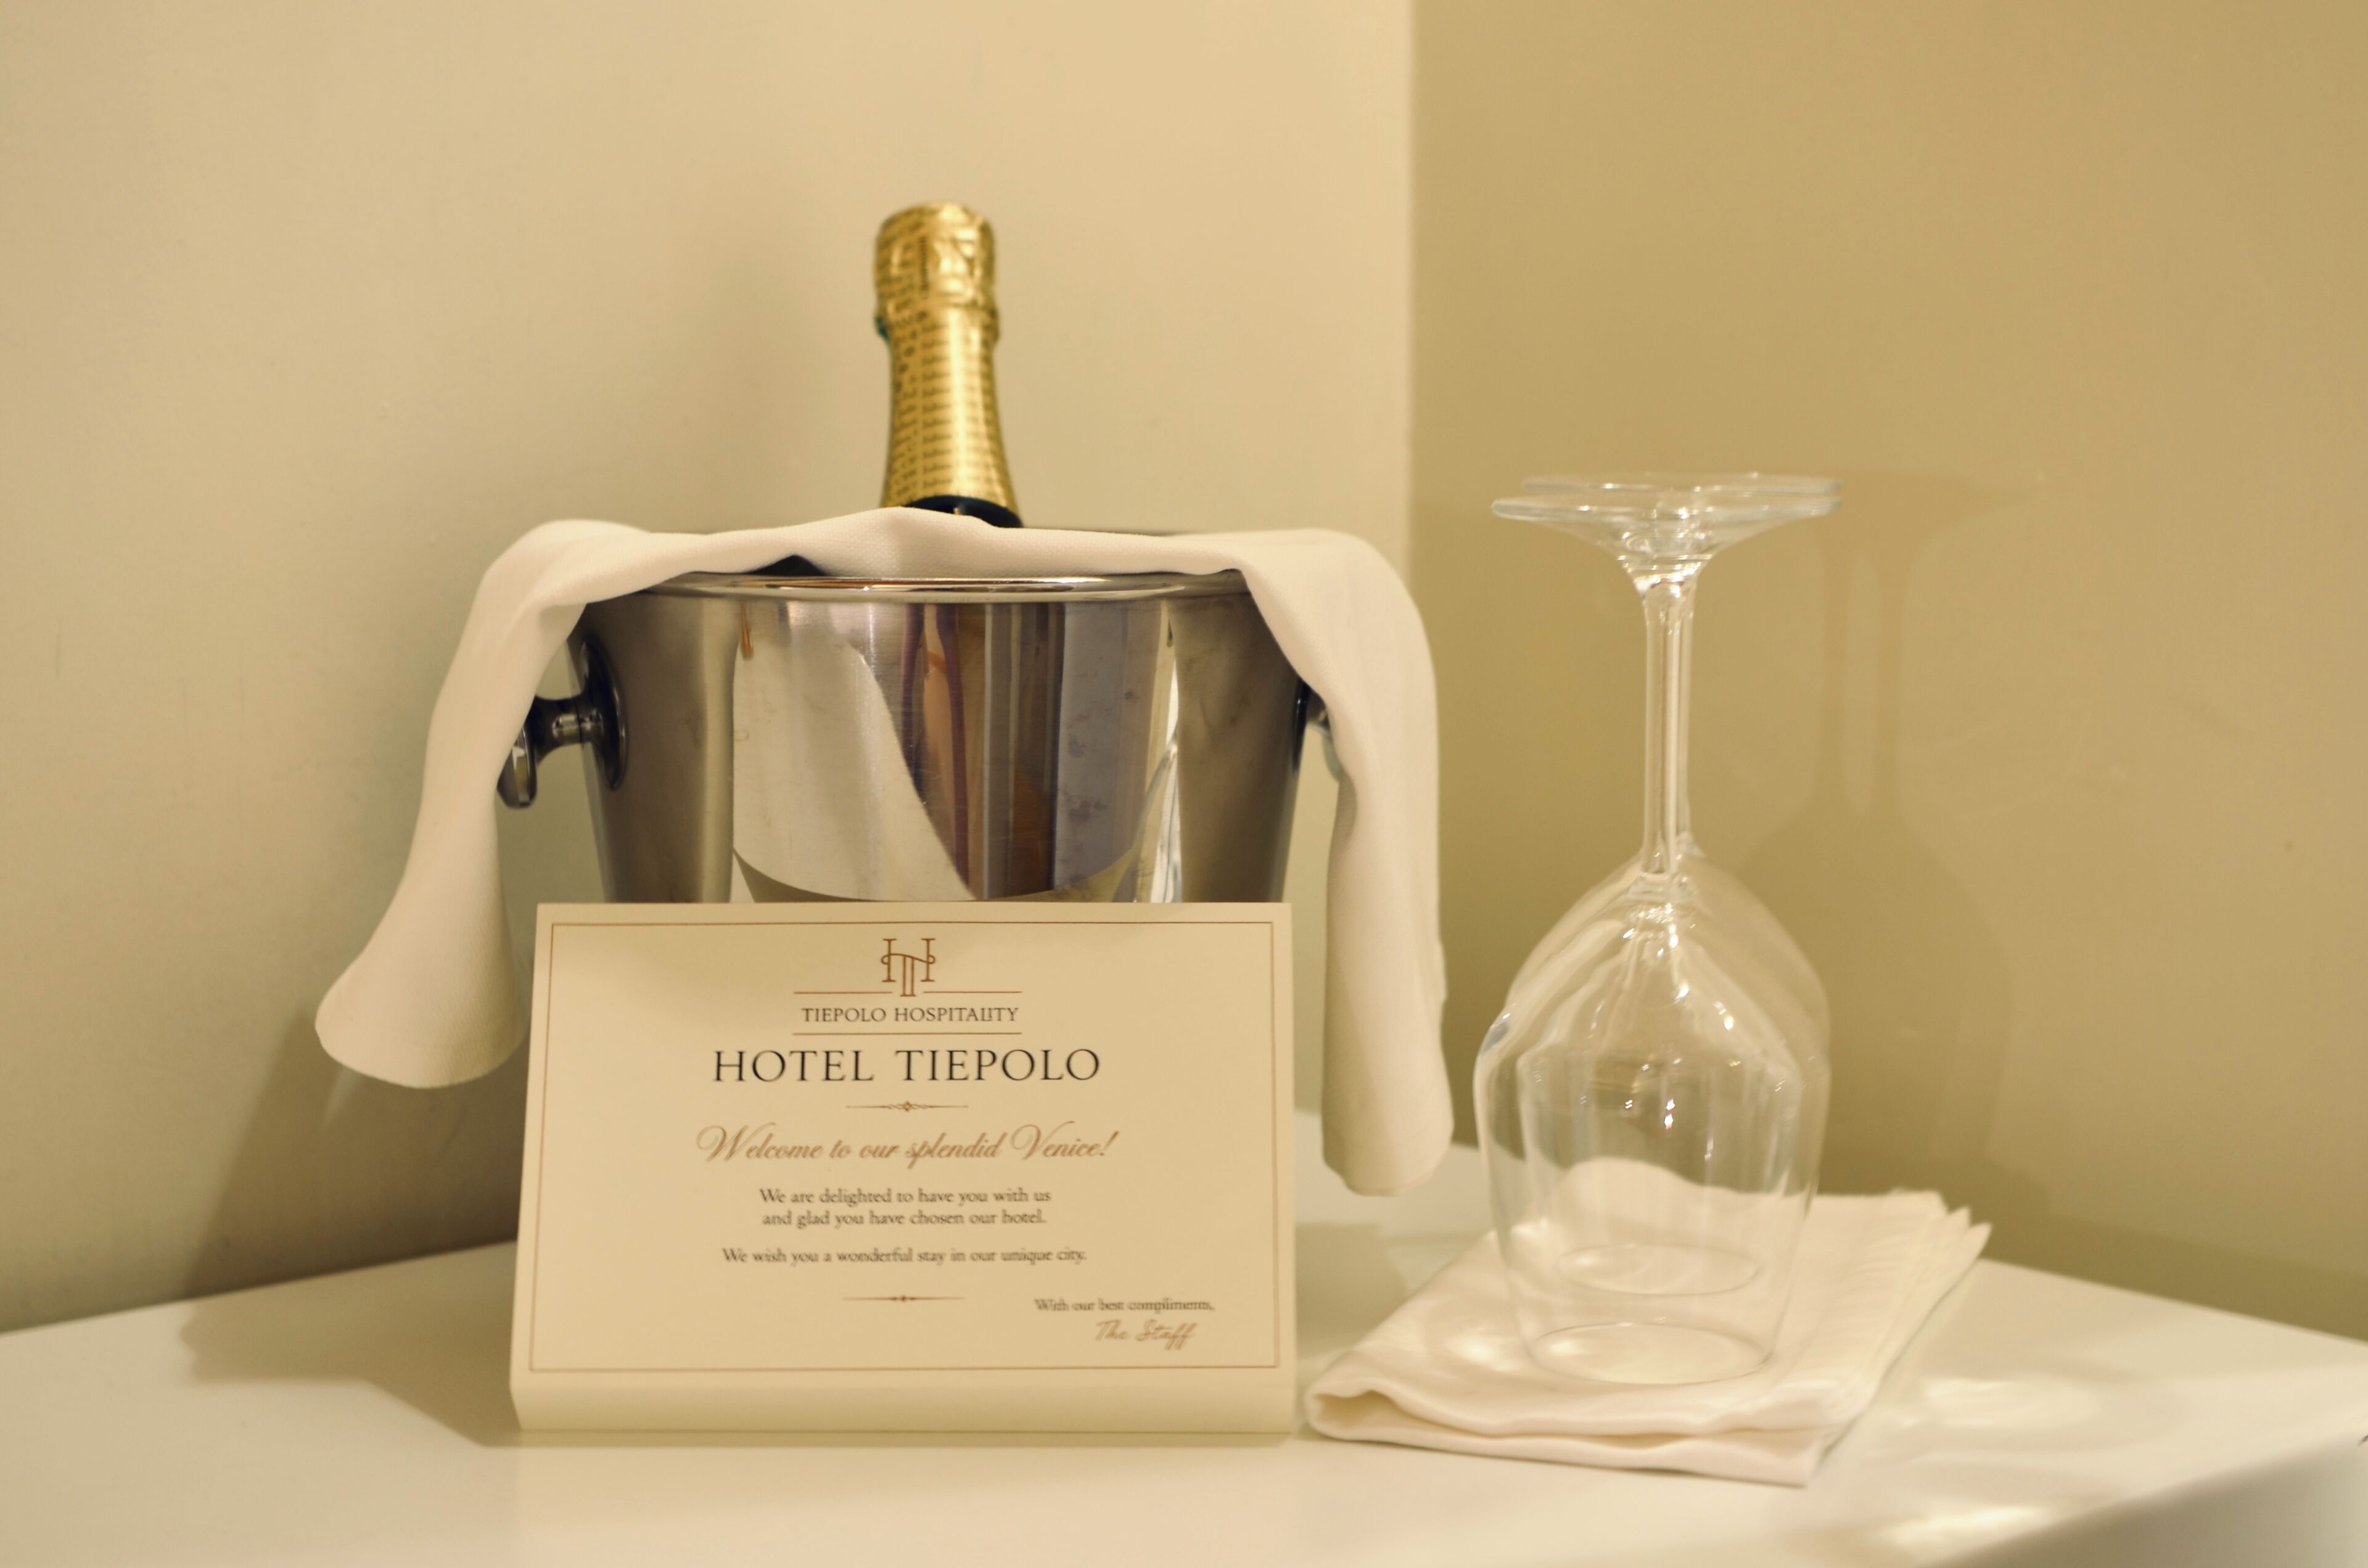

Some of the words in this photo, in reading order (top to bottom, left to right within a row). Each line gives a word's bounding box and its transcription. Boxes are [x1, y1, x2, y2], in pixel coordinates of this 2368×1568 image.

[801, 1008, 887, 1022] TIEPOLO
[894, 1007, 1019, 1022] HOSPITALITY
[713, 1049, 874, 1082] HOTEL
[895, 1048, 1100, 1081] TIEPOLO
[696, 1122, 824, 1162] Welcome
[829, 1139, 852, 1159] to
[859, 1144, 900, 1159] our
[905, 1132, 1008, 1169] splendid
[1011, 1121, 1119, 1160] Venice!
[759, 1188, 786, 1204] We
[790, 1192, 815, 1204] are
[819, 1188, 892, 1208] delighted
[897, 1192, 914, 1203] to
[918, 1188, 954, 1203] have
[958, 1192, 988, 1207] you
[992, 1187, 1029, 1202] with
[1033, 1192, 1052, 1202] us
[762, 1210, 792, 1225] and
[796, 1210, 830, 1229] glad
[834, 1214, 864, 1229] you
[869, 1210, 905, 1225] have
[909, 1209, 964, 1225] chosen
[969, 1214, 998, 1224] our
[1001, 1209, 1046, 1224] hotel.
[722, 1247, 748, 1263] We
[752, 1247, 787, 1263] wish
[791, 1252, 819, 1266] you
[823, 1252, 832, 1262] a
[836, 1247, 913, 1262] wonderful
[917, 1251, 947, 1266] stay
[950, 1248, 966, 1262] in
[969, 1252, 998, 1262] our
[1000, 1248, 1053, 1266] unique
[1056, 1247, 1087, 1265] city.
[1034, 1298, 1069, 1311] With
[1071, 1302, 1095, 1310] our
[1098, 1297, 1125, 1310] best
[1127, 1297, 1215, 1314] compliments,
[1095, 1320, 1130, 1341] The
[1135, 1319, 1198, 1350] Staff
